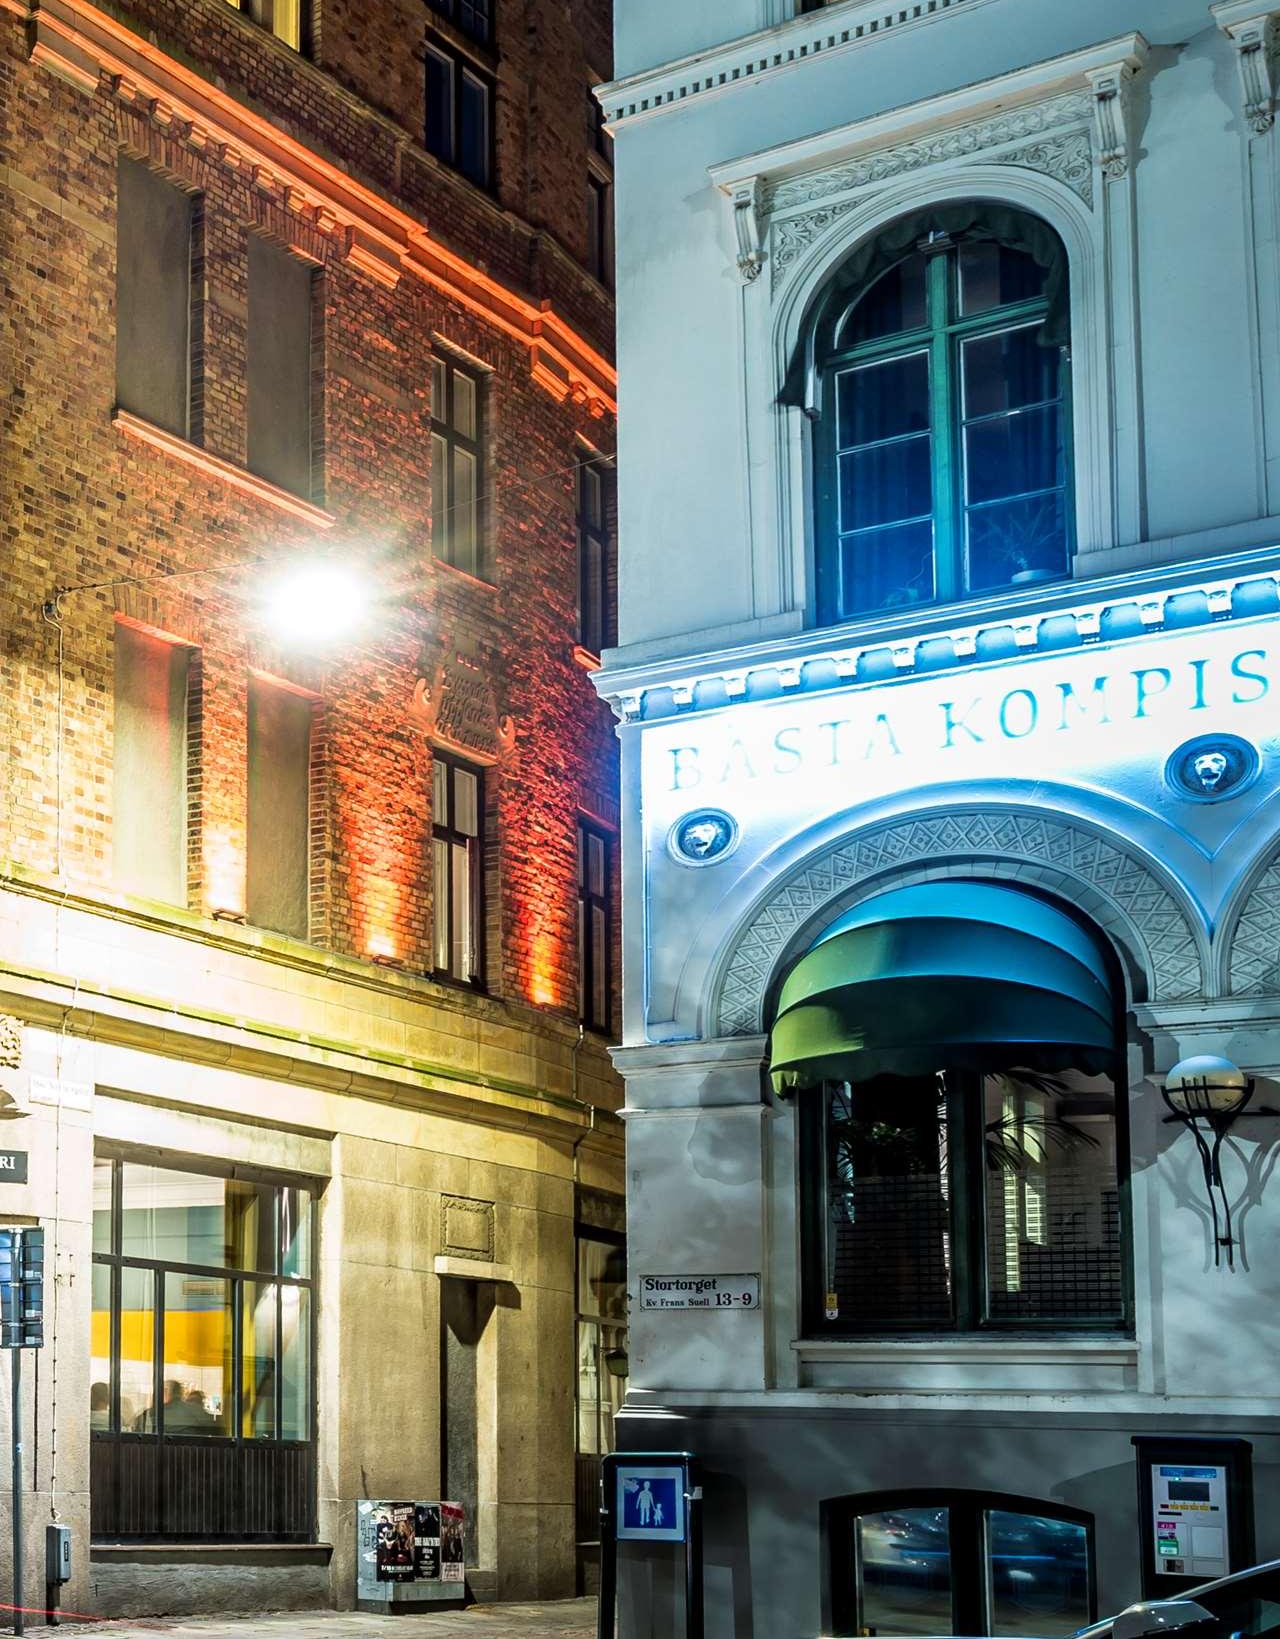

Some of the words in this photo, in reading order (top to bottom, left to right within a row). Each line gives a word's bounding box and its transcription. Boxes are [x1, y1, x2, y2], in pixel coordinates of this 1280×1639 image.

[938, 649, 1270, 749] KOMPIS
[645, 1278, 717, 1295] Stortorget
[660, 1298, 685, 1307] Frans
[688, 1297, 710, 1307] Suell
[715, 1292, 752, 1306] 13-9
